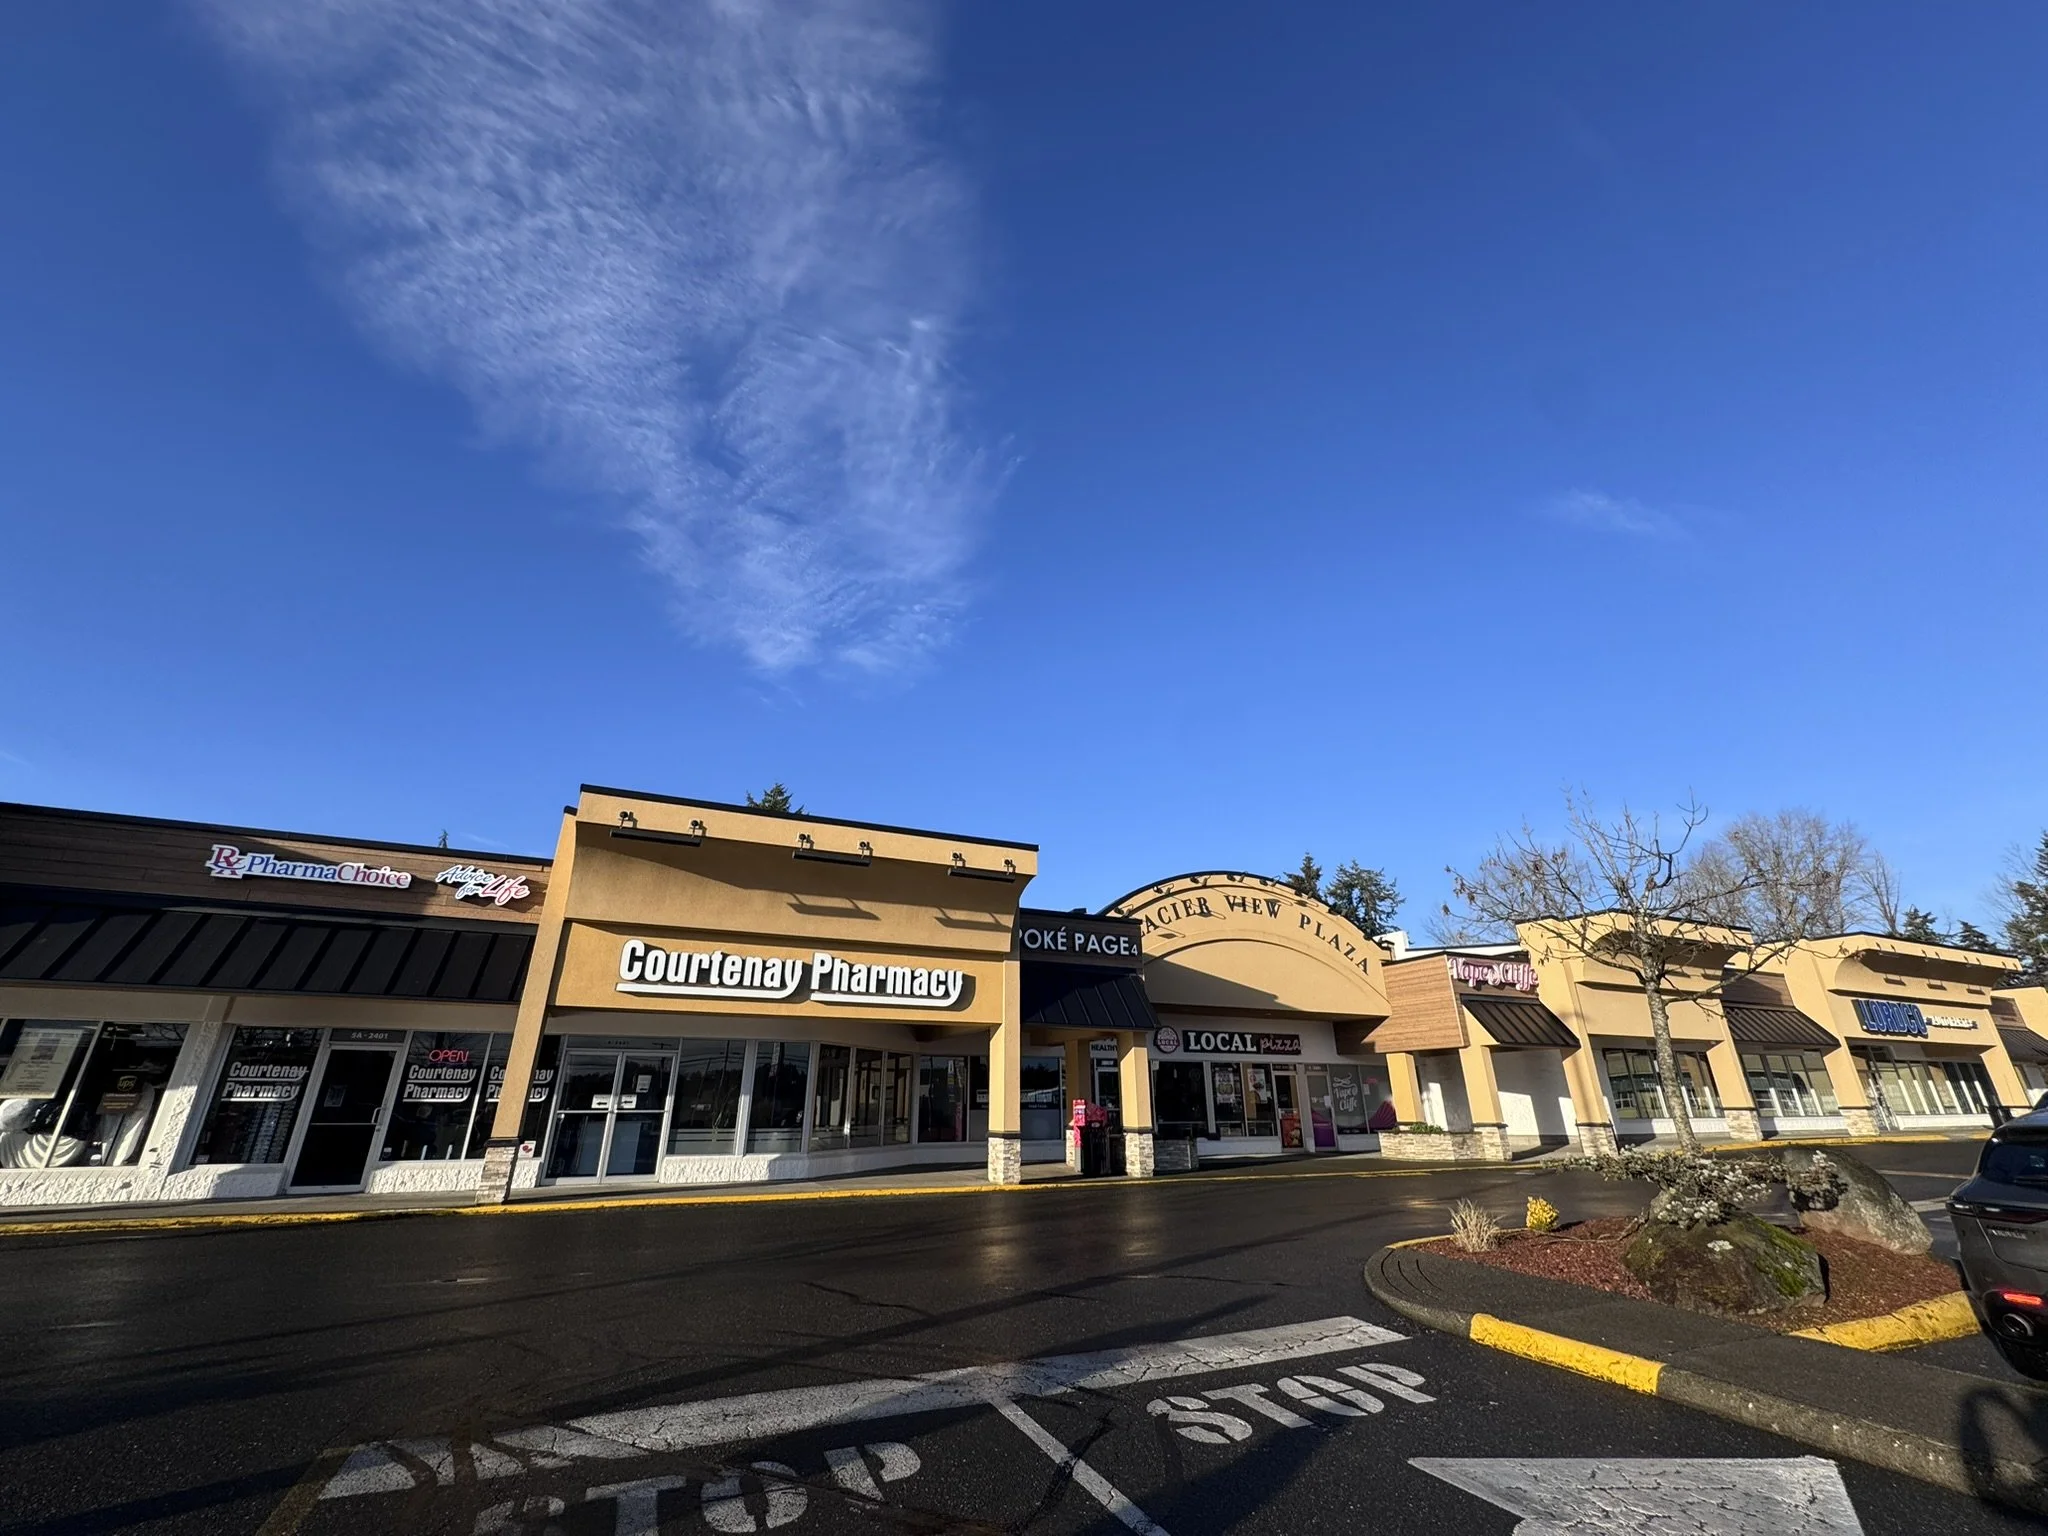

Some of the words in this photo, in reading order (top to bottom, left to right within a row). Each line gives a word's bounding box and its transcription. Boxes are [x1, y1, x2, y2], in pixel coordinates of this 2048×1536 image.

[247, 854, 411, 888] PharmaChoice
[437, 866, 493, 886] Advice
[456, 882, 481, 899] for
[480, 874, 529, 904] Life
[1141, 897, 1210, 938] ACIER
[1223, 894, 1282, 919] VIEW
[1299, 913, 1370, 976] PLAZA
[618, 938, 803, 999] Courtenay
[809, 951, 964, 1008] Pharmacy
[1859, 998, 1929, 1037] LORDCO
[1187, 1031, 1257, 1052] LOCAL
[1259, 1034, 1302, 1054] pizza
[428, 1049, 469, 1064] OPEN
[228, 1061, 308, 1083] Courtenay
[407, 1065, 477, 1083] Courtenay
[221, 1081, 300, 1101] Pharmacy
[402, 1083, 471, 1102] Pharmacy
[1145, 1361, 1439, 1445] STOP
